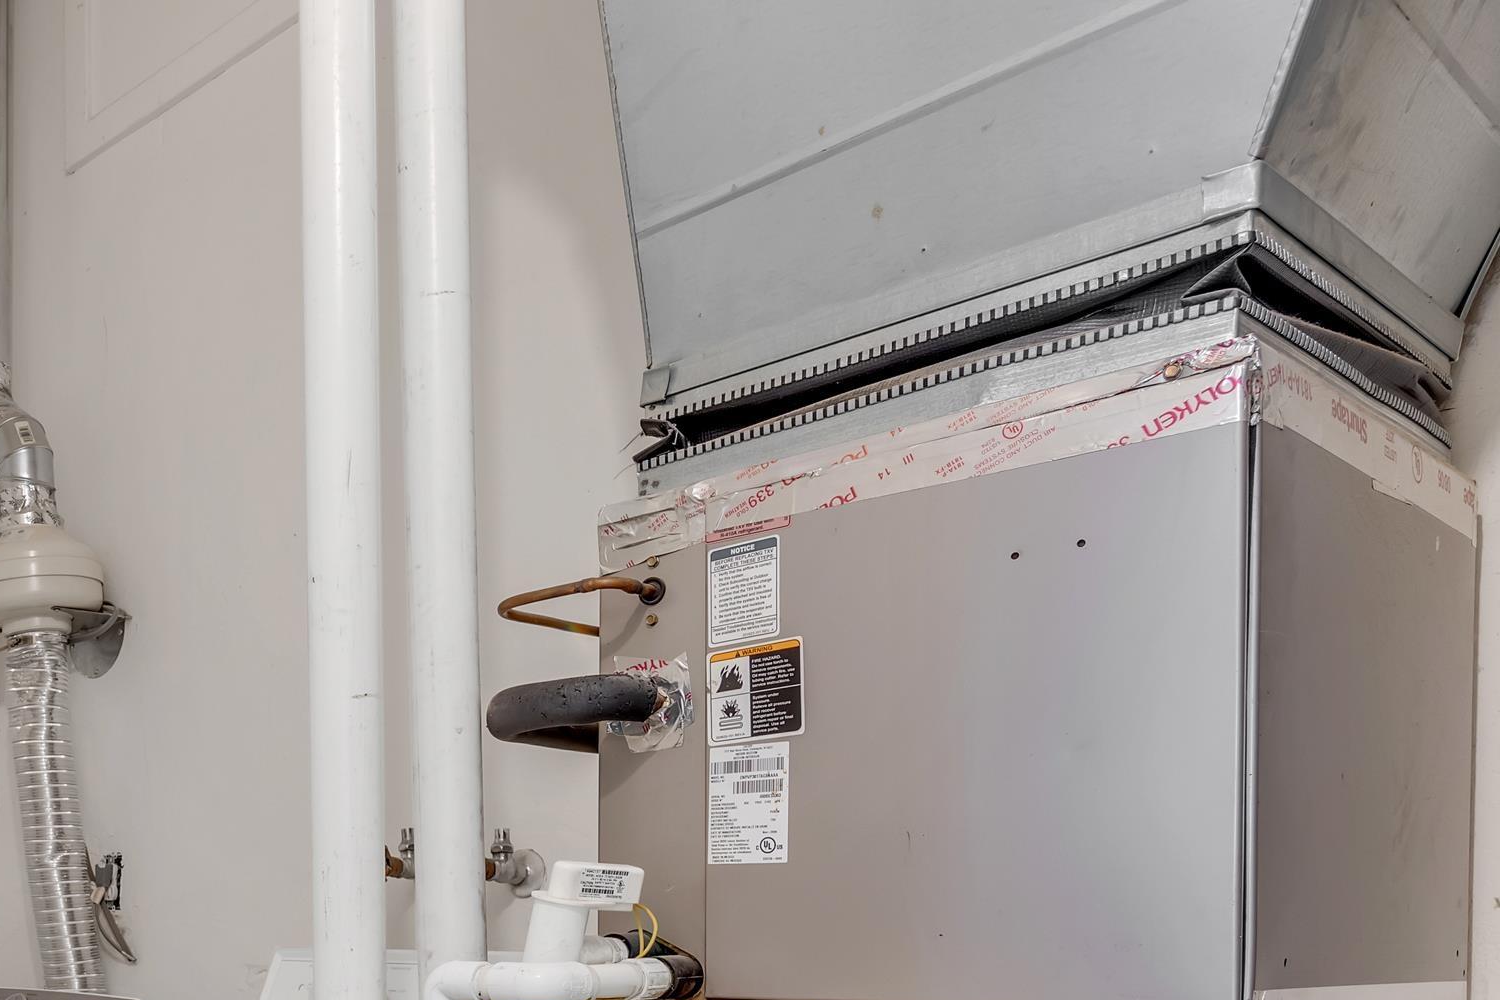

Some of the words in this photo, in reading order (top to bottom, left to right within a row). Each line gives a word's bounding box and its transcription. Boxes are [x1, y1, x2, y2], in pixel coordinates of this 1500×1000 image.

[1023, 433, 1044, 449] DUCT
[1006, 447, 1021, 459] AND
[748, 484, 775, 508] 339
[730, 544, 755, 556] NOTICE
[713, 560, 739, 572] COMPLETE
[740, 557, 756, 565] THESE
[714, 556, 734, 566] BEFORE
[735, 550, 763, 560] REPLACING
[742, 645, 773, 655] WARNING
[763, 840, 772, 850] UL
